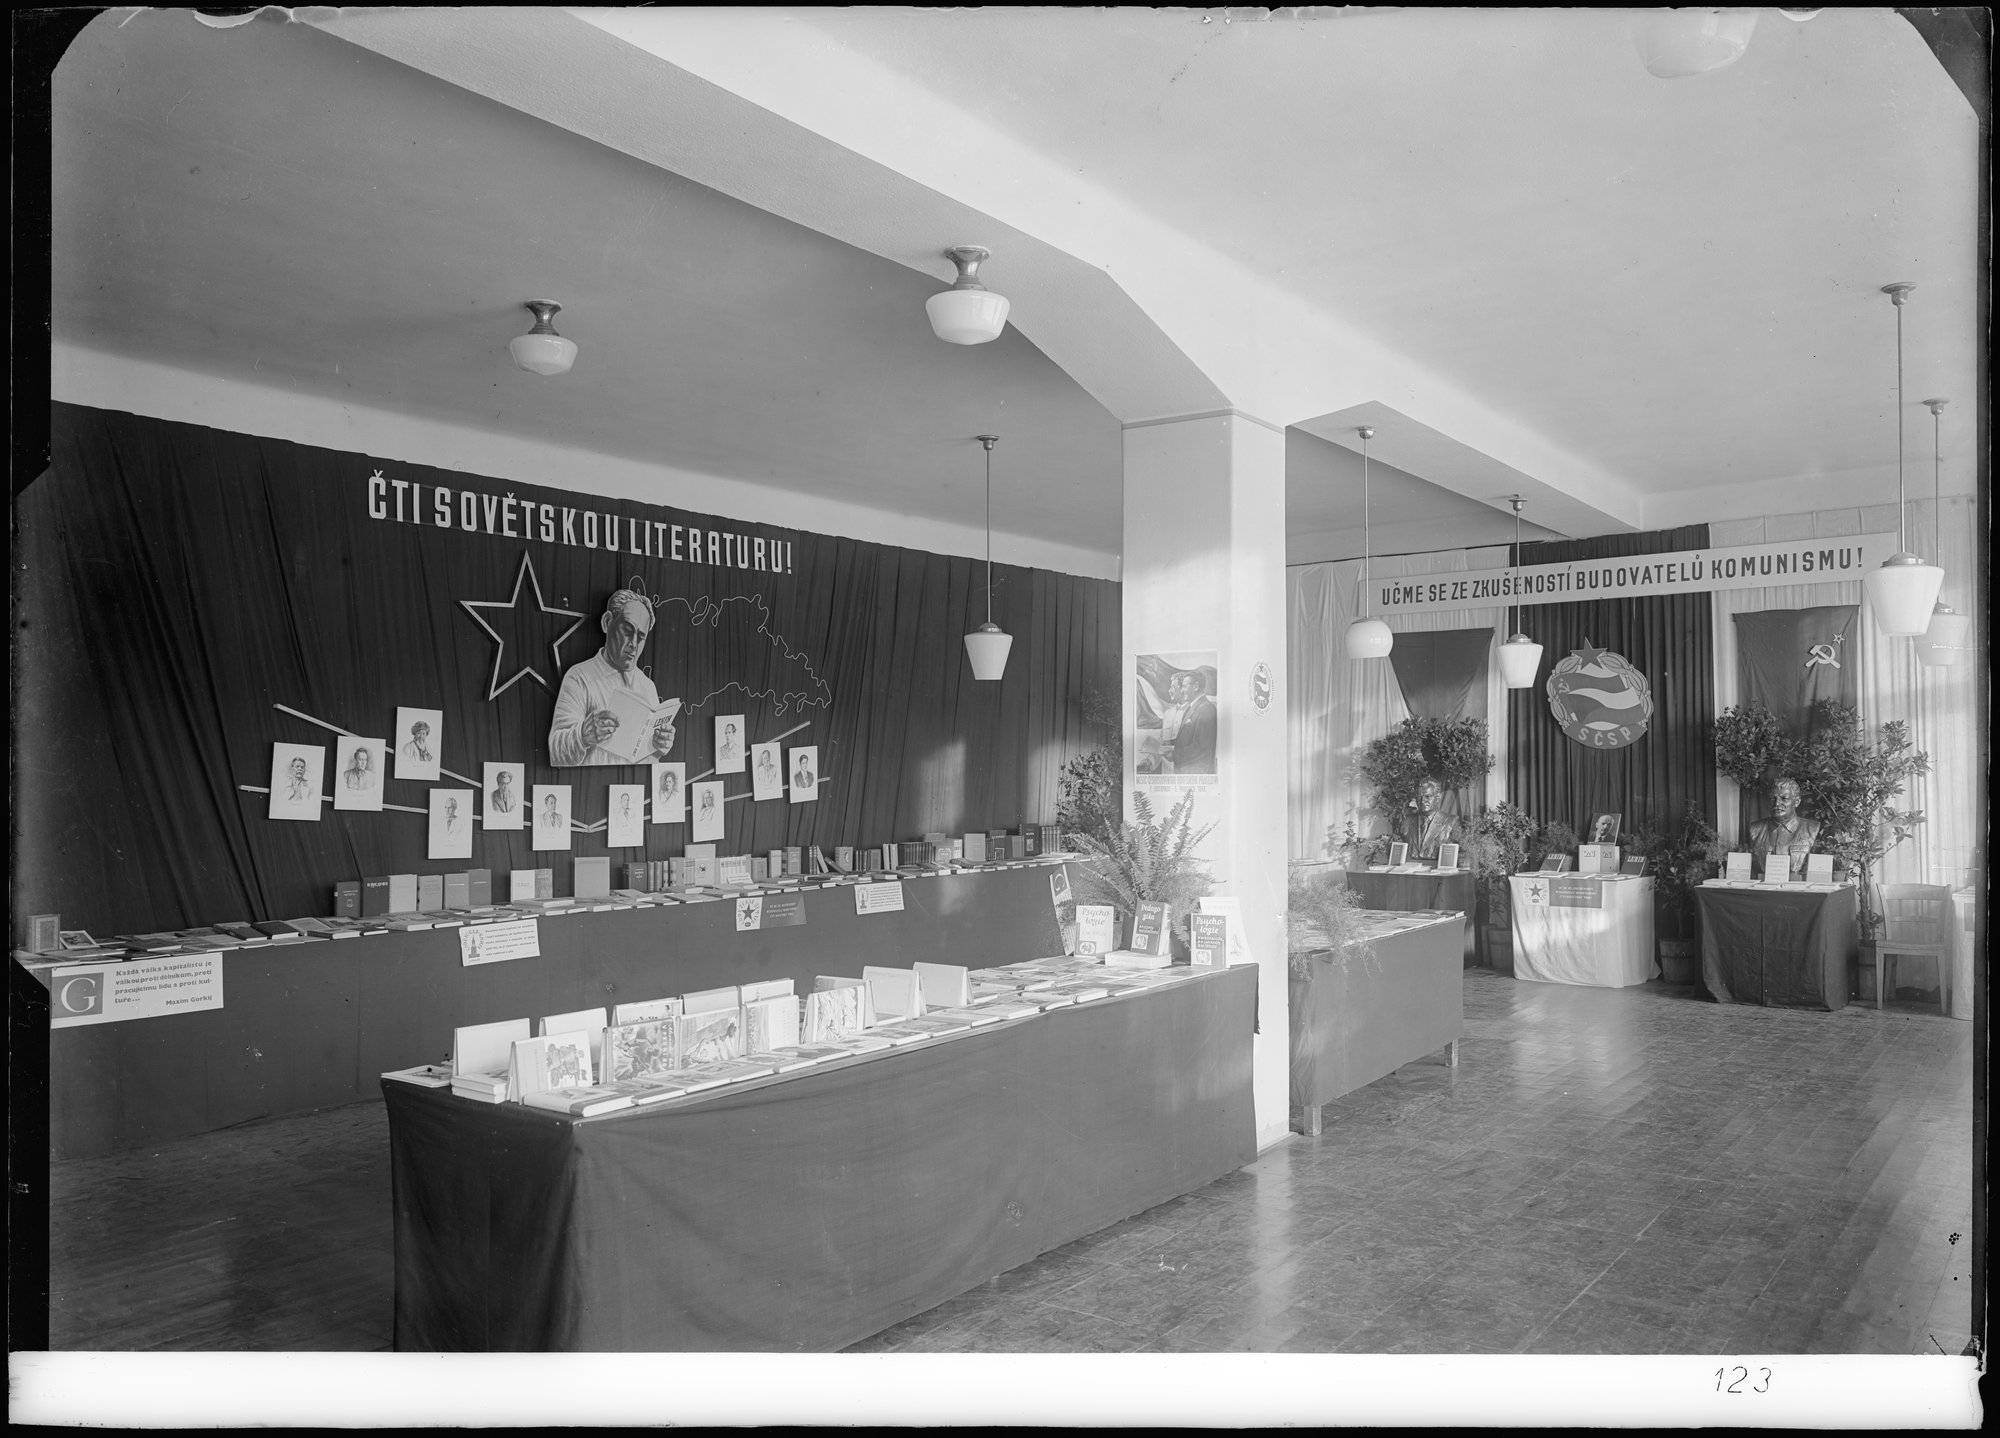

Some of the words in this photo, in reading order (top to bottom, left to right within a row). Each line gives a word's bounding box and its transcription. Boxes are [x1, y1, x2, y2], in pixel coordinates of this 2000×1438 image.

[369, 469, 420, 524] ČTI
[434, 486, 619, 552] SOVĚTSKOU
[630, 517, 792, 575] LITERATURU!
[1382, 581, 1424, 606] UČME
[1428, 583, 1447, 602] SE
[1451, 581, 1468, 600] ZE
[1472, 565, 1572, 599] ZKUŠENOSTÍ
[1576, 554, 1704, 590] BUDOVATELŮ
[1711, 547, 1863, 579] KOMUNISMU!
[1196, 916, 1225, 927] Psycho-
[1200, 925, 1219, 936] logie
[60, 977, 97, 1013] G
